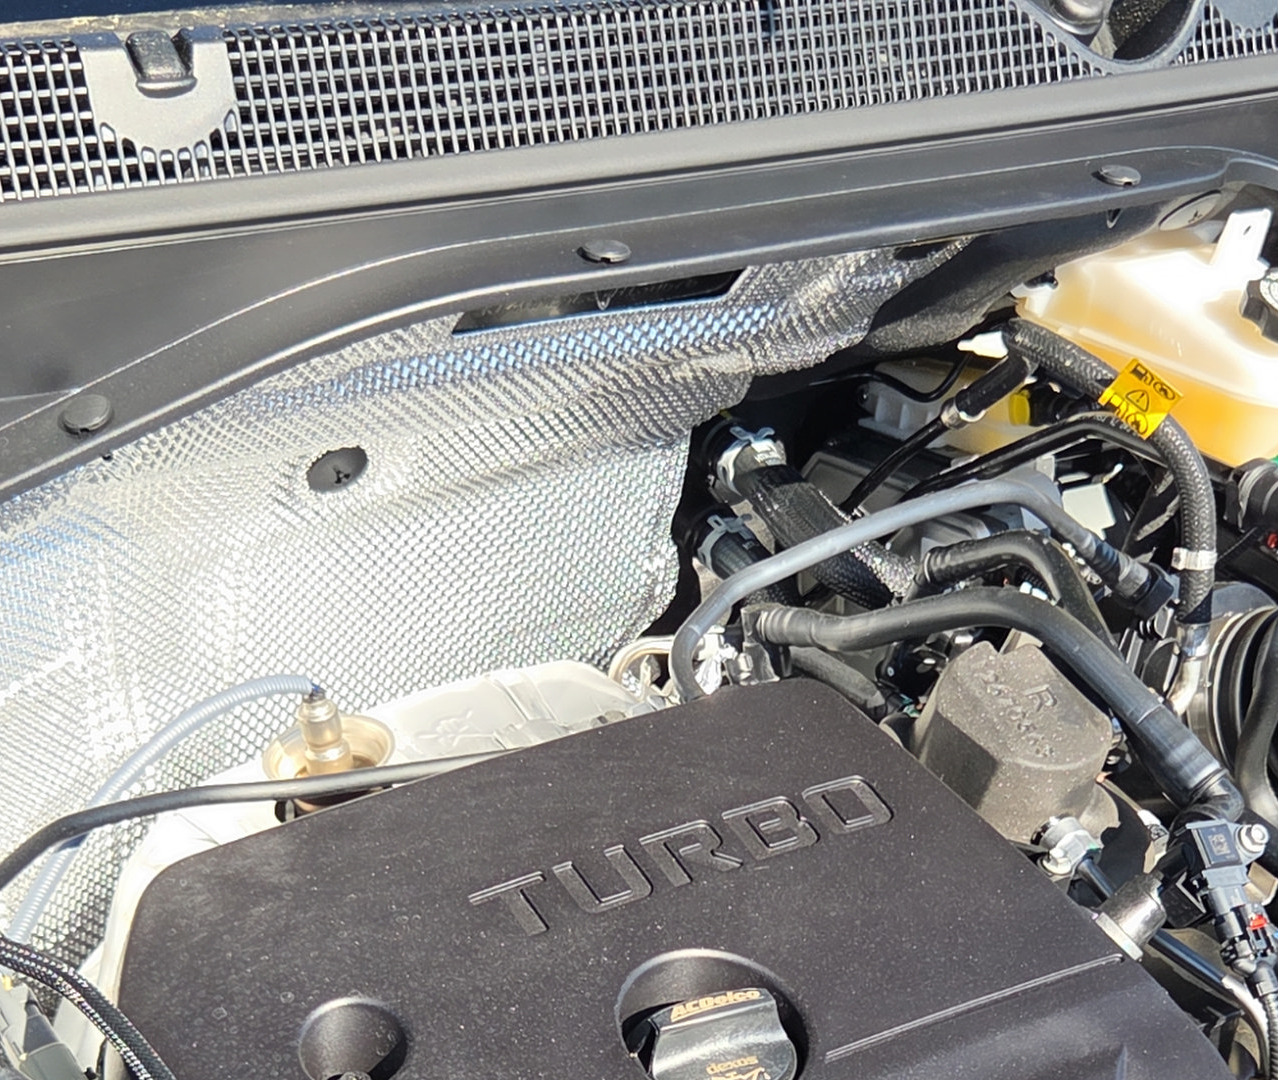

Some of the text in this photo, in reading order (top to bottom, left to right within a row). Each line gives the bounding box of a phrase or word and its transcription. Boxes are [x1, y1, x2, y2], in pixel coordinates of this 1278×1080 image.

[468, 775, 895, 937] TURBO
[671, 990, 761, 1021] ACDelco
[706, 1055, 759, 1075] dexos
